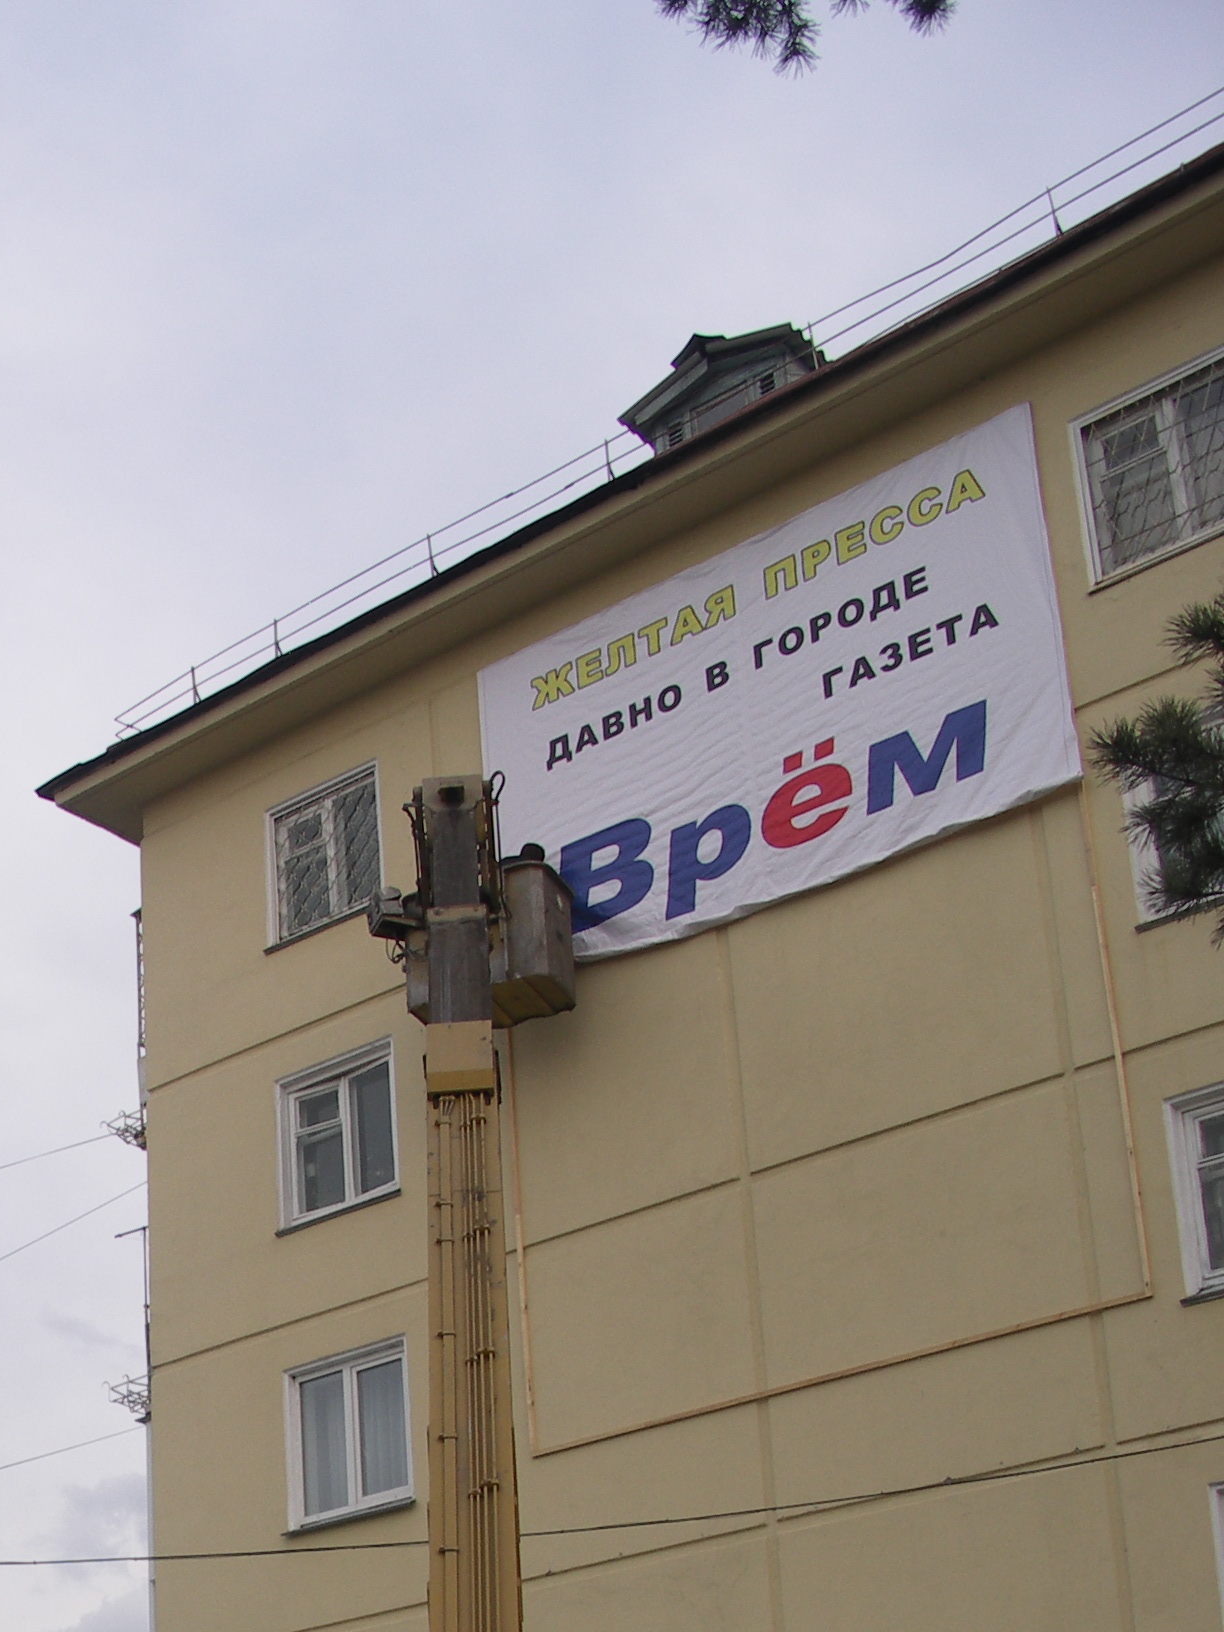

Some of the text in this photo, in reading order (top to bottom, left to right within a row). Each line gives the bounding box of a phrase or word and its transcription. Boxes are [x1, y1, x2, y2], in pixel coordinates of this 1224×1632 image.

[531, 469, 986, 711] ЖЕЛТАЯ ПРЕССА
[546, 566, 930, 771] ДАВНО В ГОРОДЕ
[822, 604, 999, 699] ГАЗЕТА
[559, 700, 987, 935] Врём
